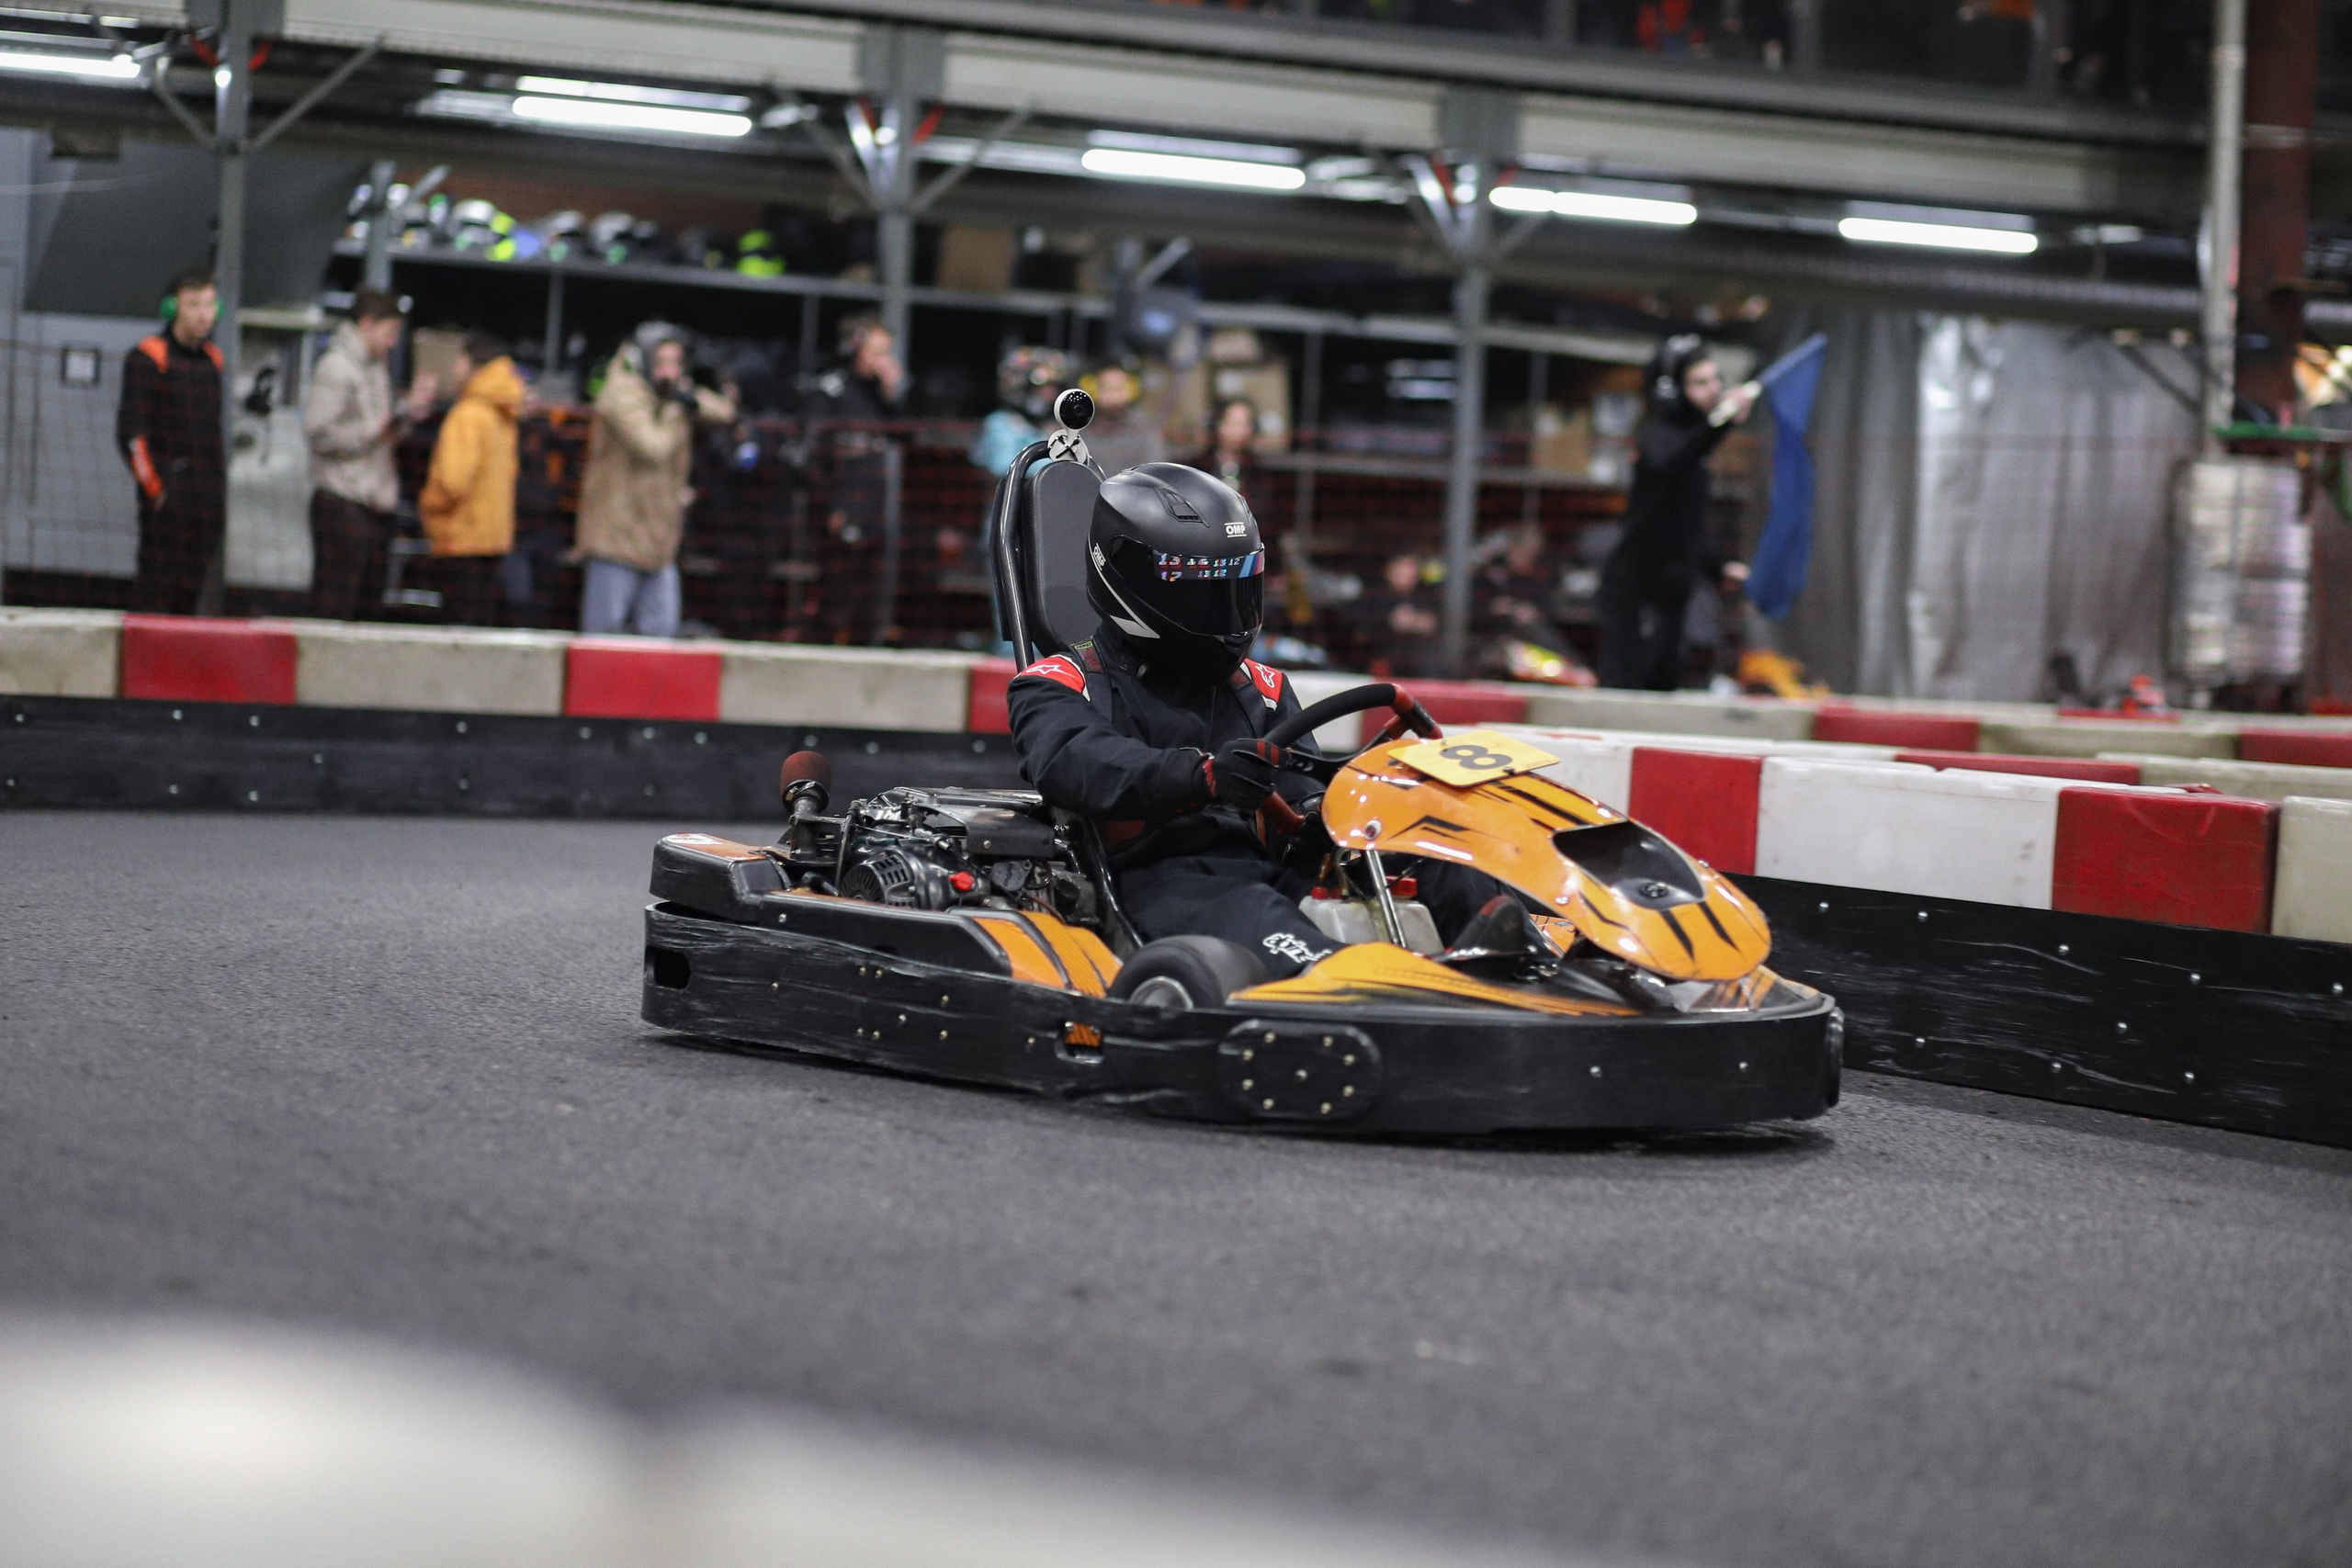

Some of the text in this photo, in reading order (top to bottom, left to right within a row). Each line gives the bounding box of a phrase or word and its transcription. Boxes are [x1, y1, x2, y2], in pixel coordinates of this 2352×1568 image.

[1225, 524, 1247, 536] OMP
[1092, 545, 1105, 568] OMP
[1440, 745, 1512, 770] 8
